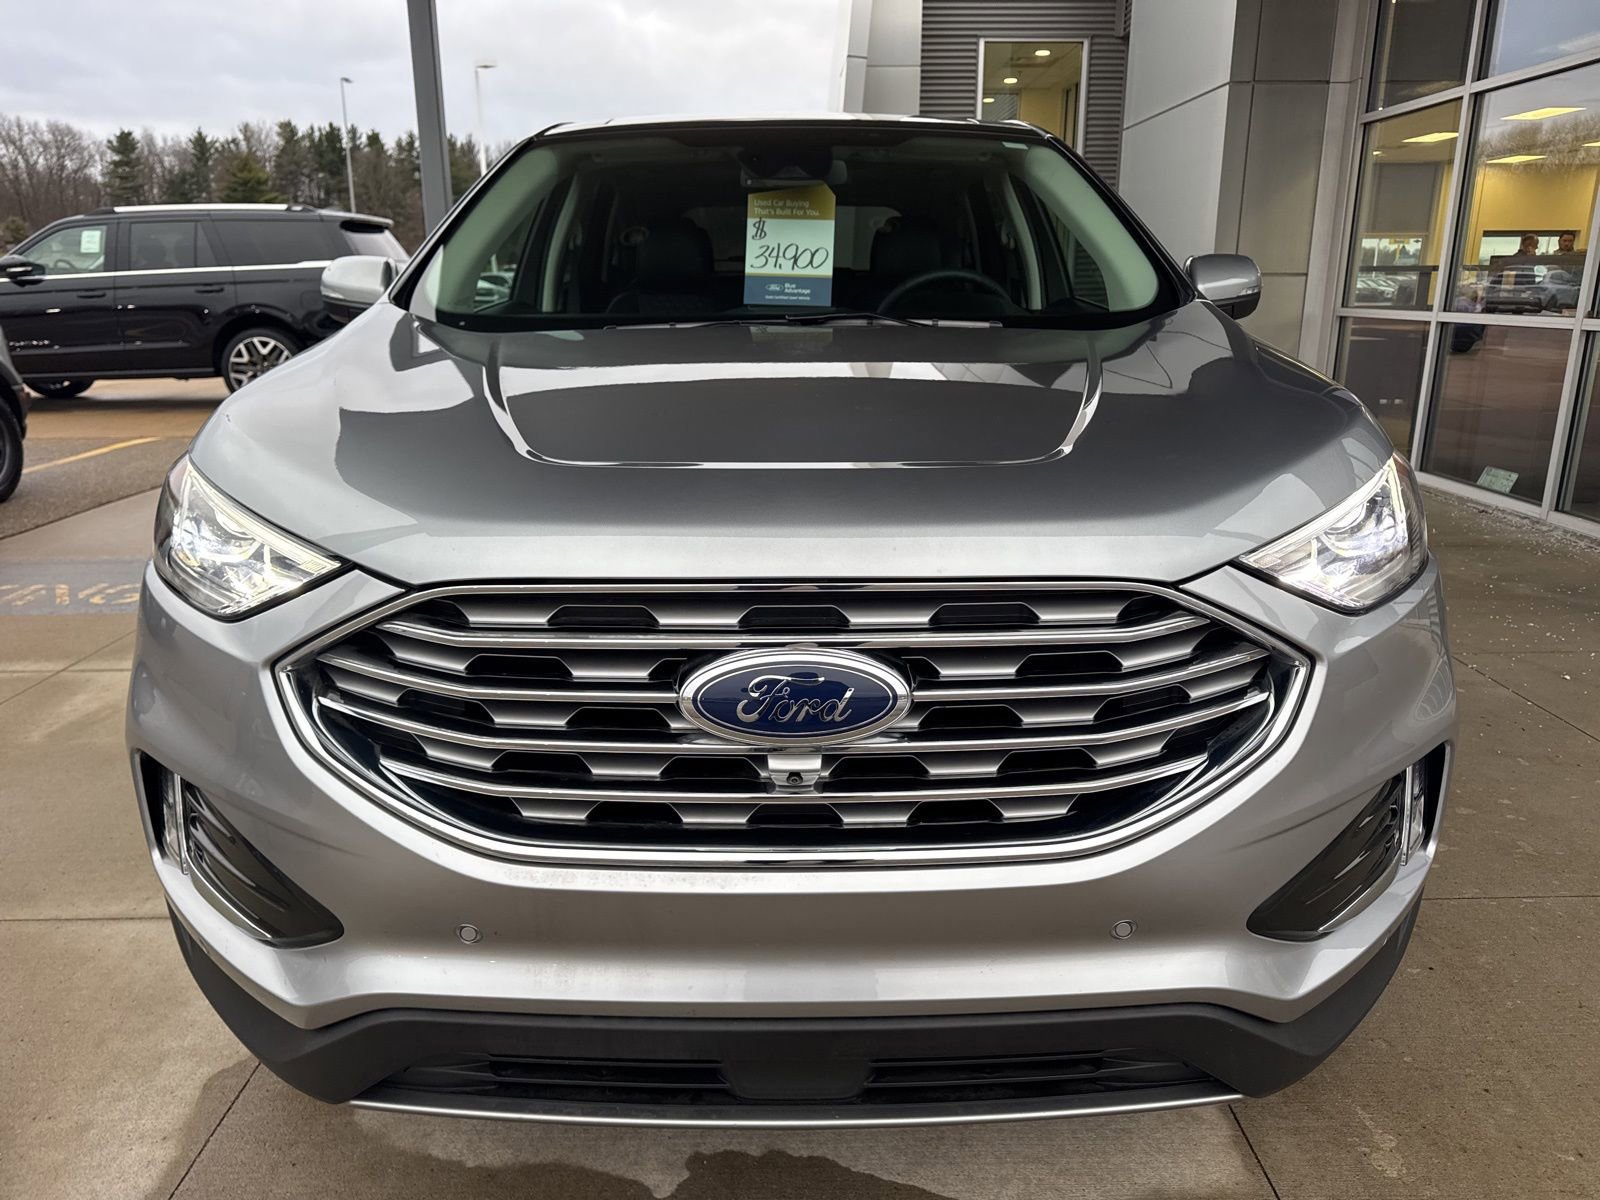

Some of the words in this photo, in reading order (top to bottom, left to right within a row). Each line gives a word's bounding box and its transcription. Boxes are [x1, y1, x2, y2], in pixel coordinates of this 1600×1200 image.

[773, 199, 785, 207] Car
[786, 199, 810, 209] Buying
[793, 208, 804, 216] For
[752, 217, 767, 240] $
[736, 674, 855, 723] Ford
